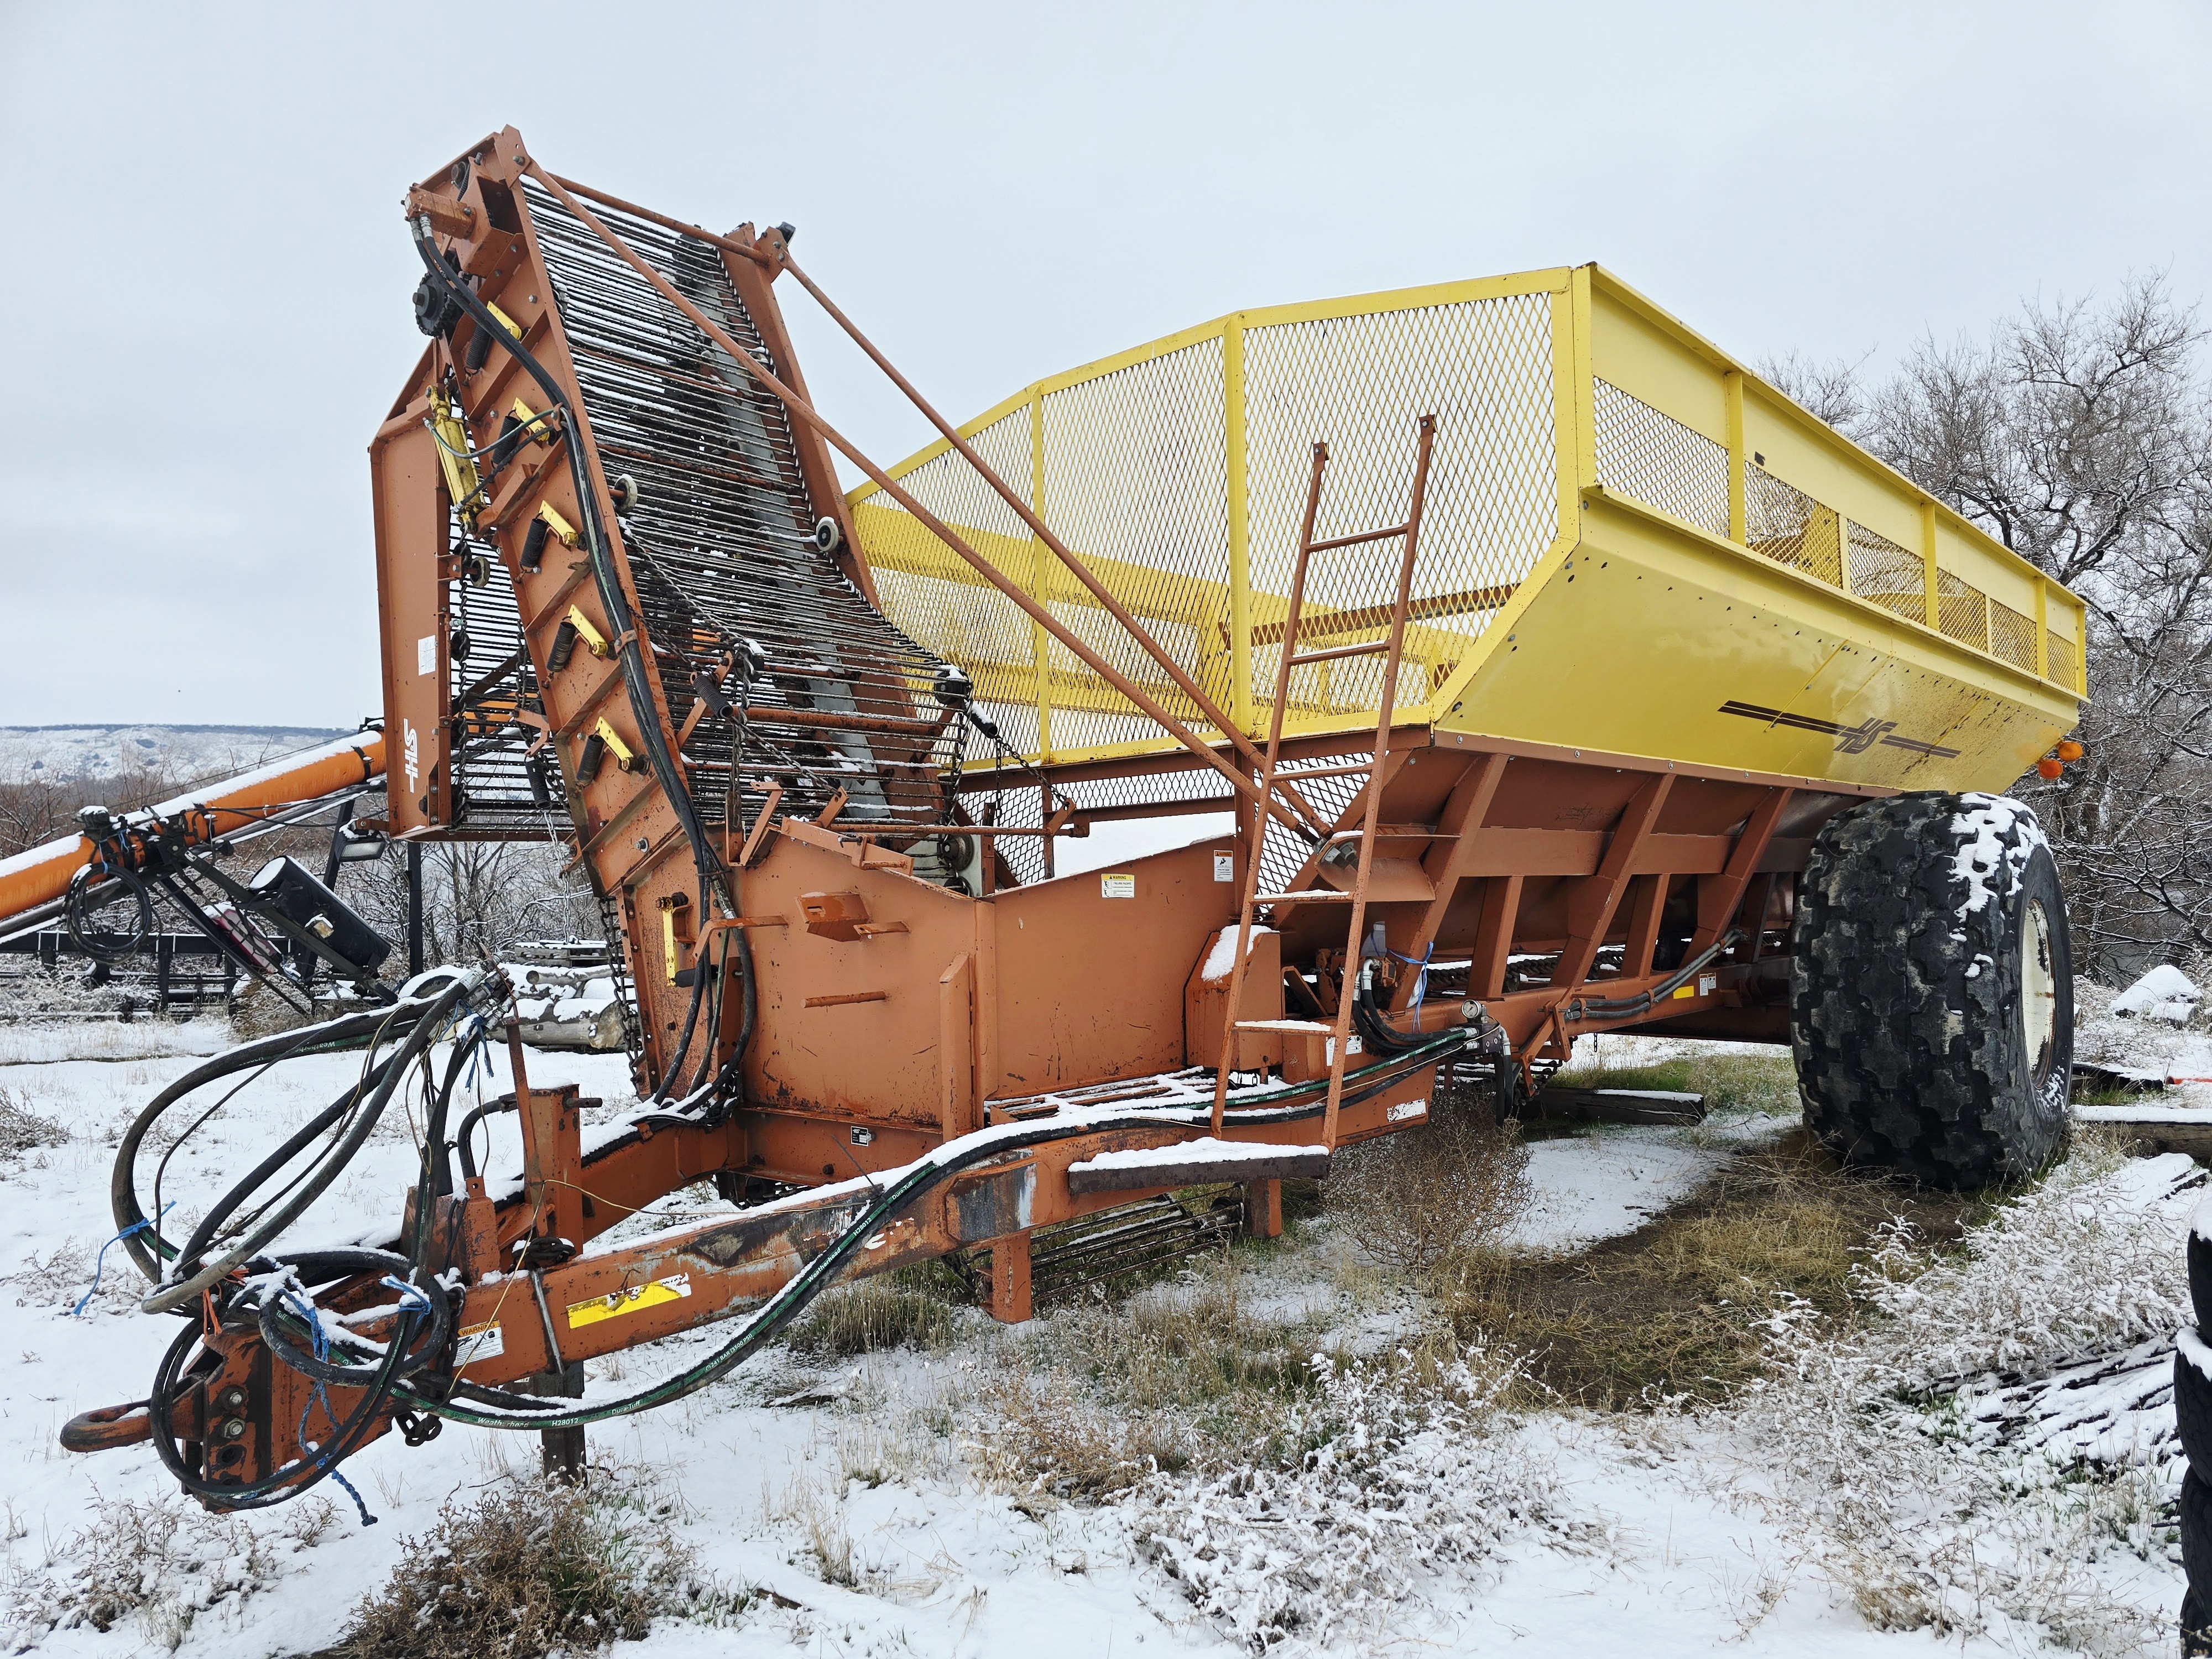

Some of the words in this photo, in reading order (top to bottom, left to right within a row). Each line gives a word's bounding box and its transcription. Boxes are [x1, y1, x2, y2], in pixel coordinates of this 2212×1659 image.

[295, 1041, 335, 1053] Weatherh
[807, 1247, 842, 1282] Weatherhead
[853, 1217, 872, 1236] H28012
[891, 1180, 914, 1199] Dura-Tuff
[461, 1322, 495, 1335] WARNING
[477, 1417, 528, 1428] Weathrhead
[551, 1417, 578, 1426] H28012
[612, 1400, 640, 1415] Dura-Tuff
[711, 1359, 720, 1368] 241
[719, 1351, 730, 1361] BAR
[730, 1340, 744, 1353] (3500
[743, 1333, 753, 1344] PSI)
